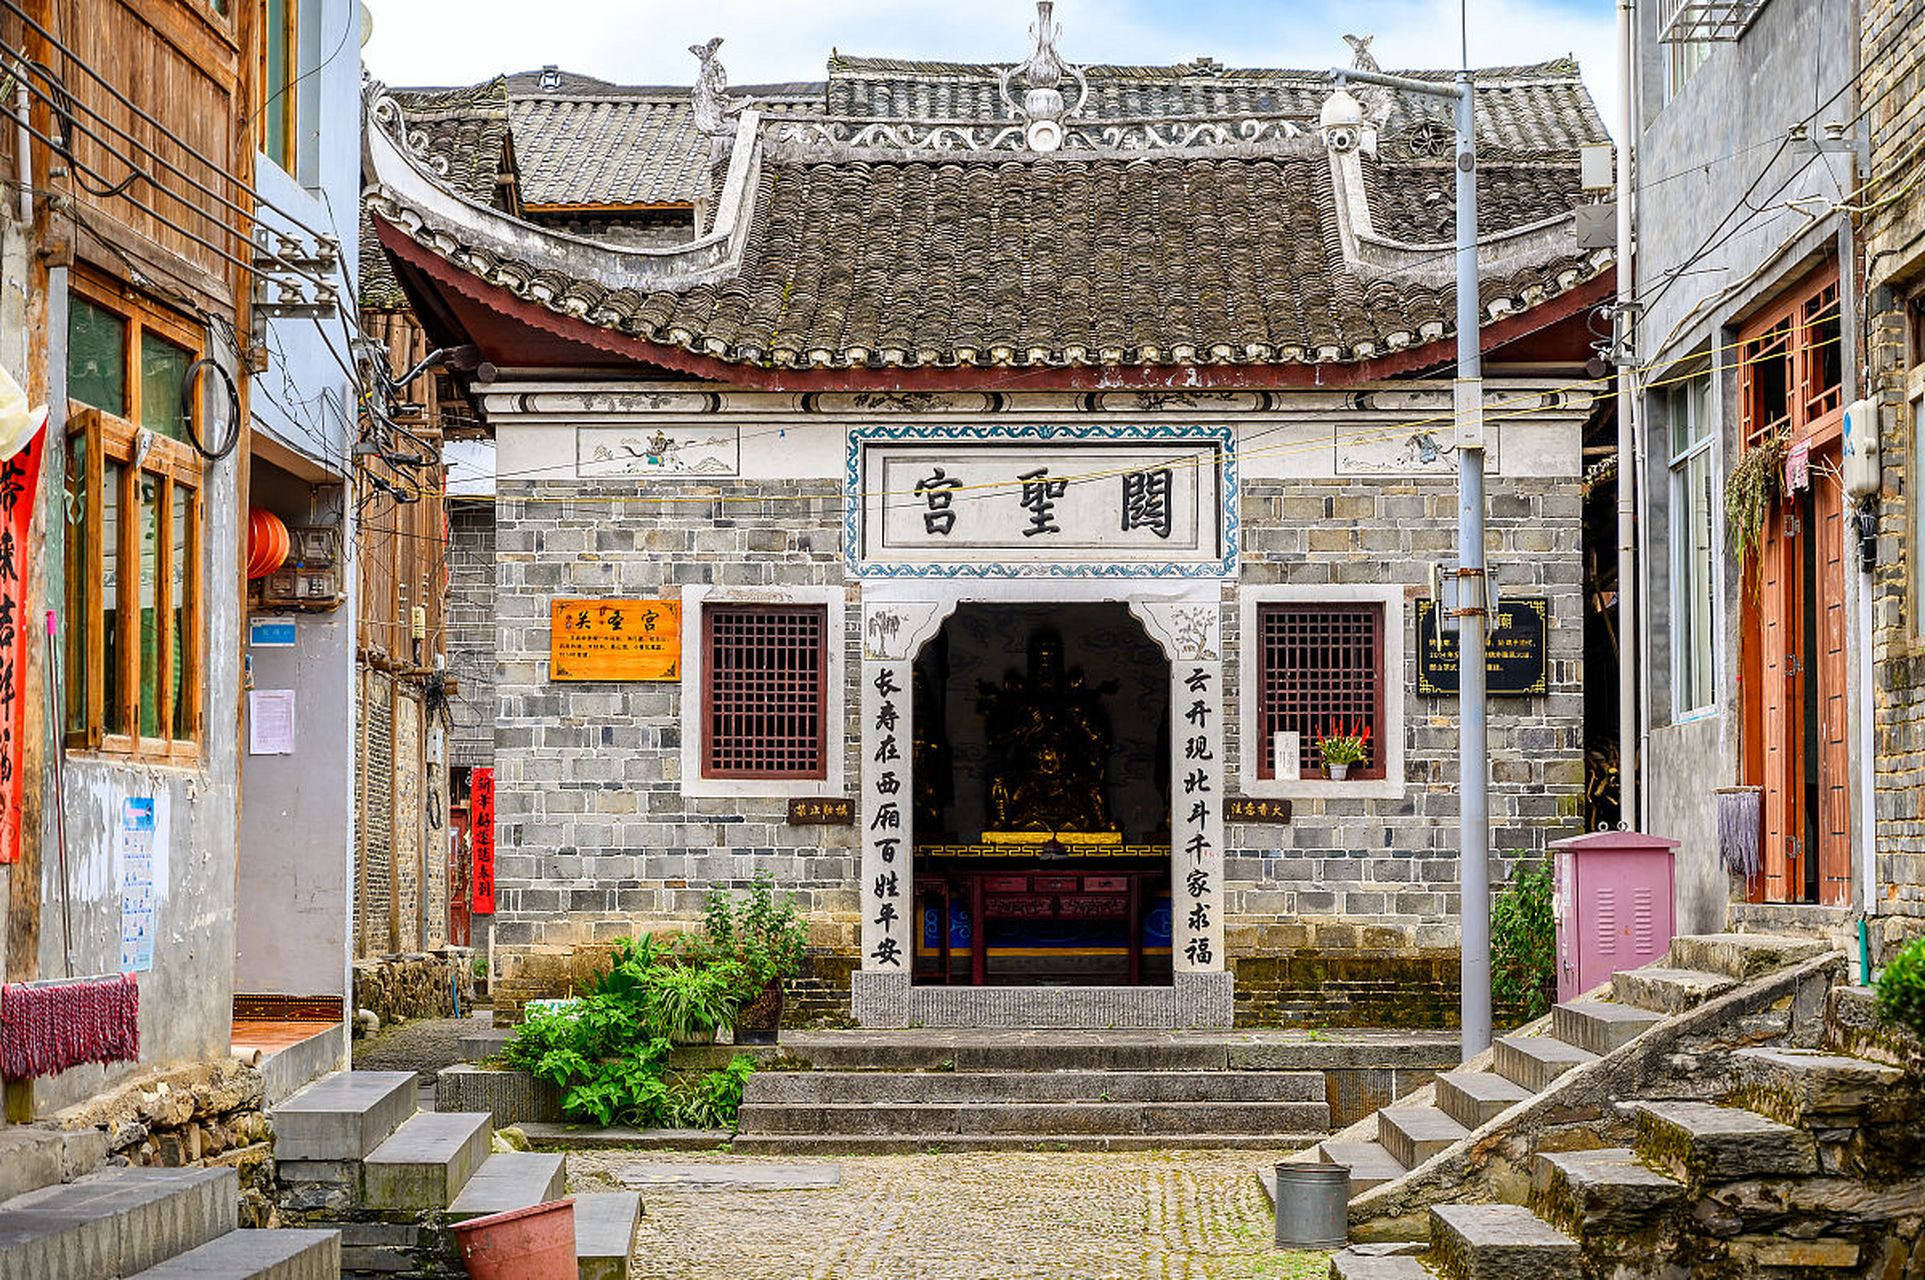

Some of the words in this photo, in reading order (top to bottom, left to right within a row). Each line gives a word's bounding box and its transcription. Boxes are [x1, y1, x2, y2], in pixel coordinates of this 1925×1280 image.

[575, 608, 660, 632] 关圣宫
[870, 668, 902, 966] 长寿在西厢百姓平安
[1184, 668, 1213, 966] 云开现北斗千家求福
